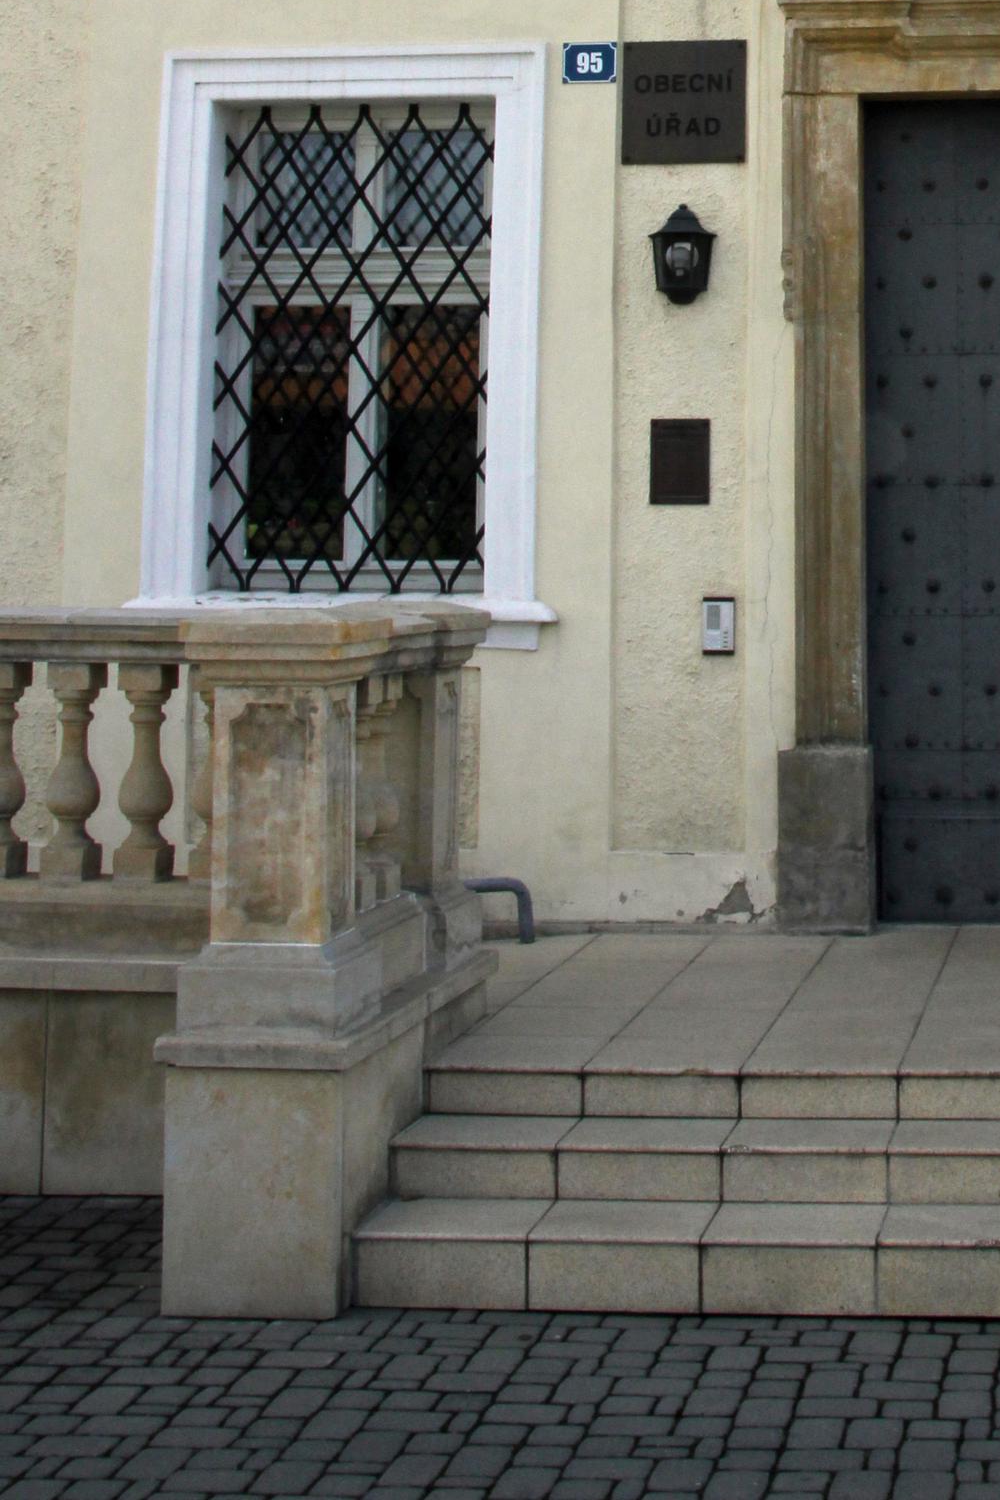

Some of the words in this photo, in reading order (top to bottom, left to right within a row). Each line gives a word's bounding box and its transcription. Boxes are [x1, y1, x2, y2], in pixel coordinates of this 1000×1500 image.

[576, 52, 603, 74] 95
[634, 69, 733, 94] OBECNÍ
[646, 112, 722, 137] ÚŘAD
